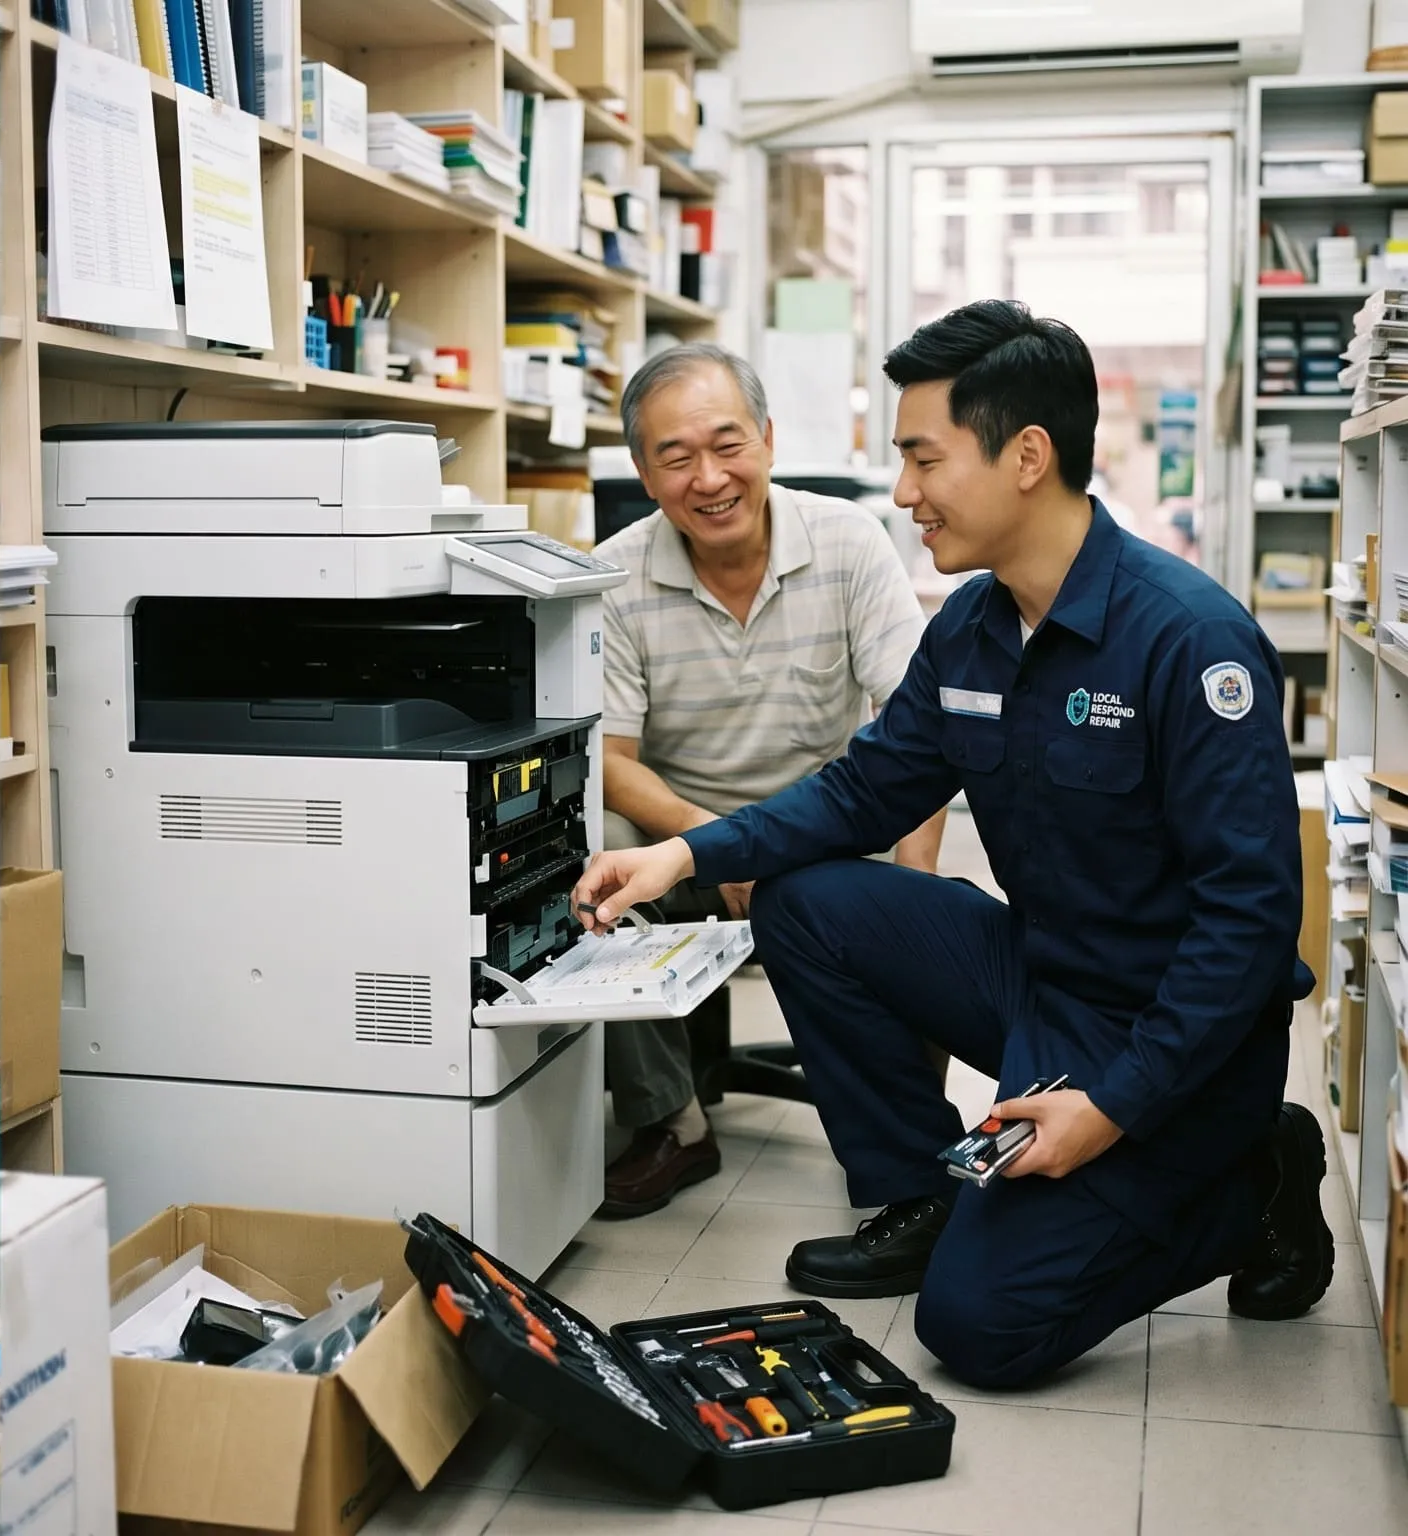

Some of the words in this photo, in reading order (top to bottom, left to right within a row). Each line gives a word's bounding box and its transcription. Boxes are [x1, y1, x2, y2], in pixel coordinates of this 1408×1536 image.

[1092, 692, 1122, 705] LOCAL
[1091, 703, 1135, 718] RESPOND
[1089, 715, 1121, 729] REPAIR
